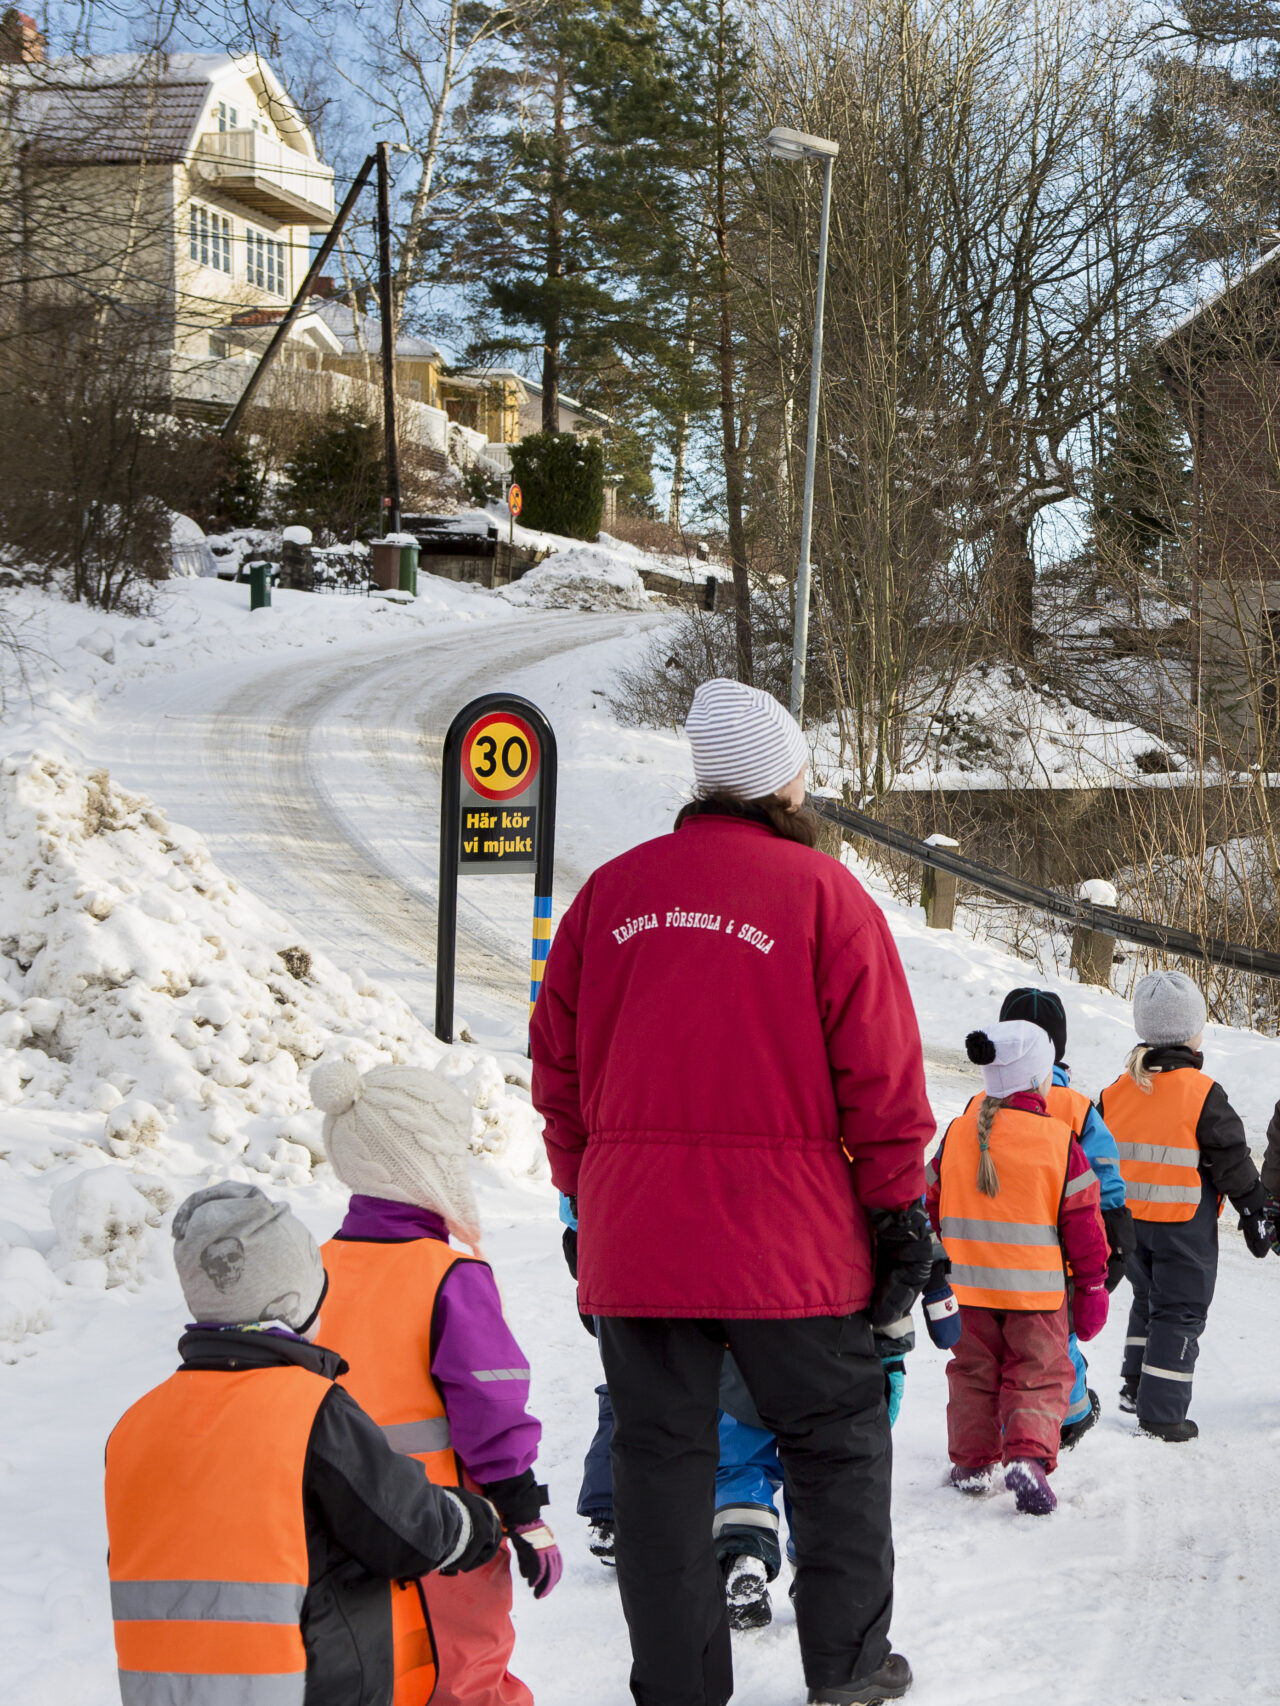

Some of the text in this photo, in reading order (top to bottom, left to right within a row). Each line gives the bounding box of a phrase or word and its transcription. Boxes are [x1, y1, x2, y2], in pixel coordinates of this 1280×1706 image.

[474, 735, 528, 778] 30
[466, 811, 530, 829] Här kör
[463, 836, 533, 857] vi mjukt
[611, 907, 775, 955] KRÄPPLA FÖRSKOLA & SKOLA
